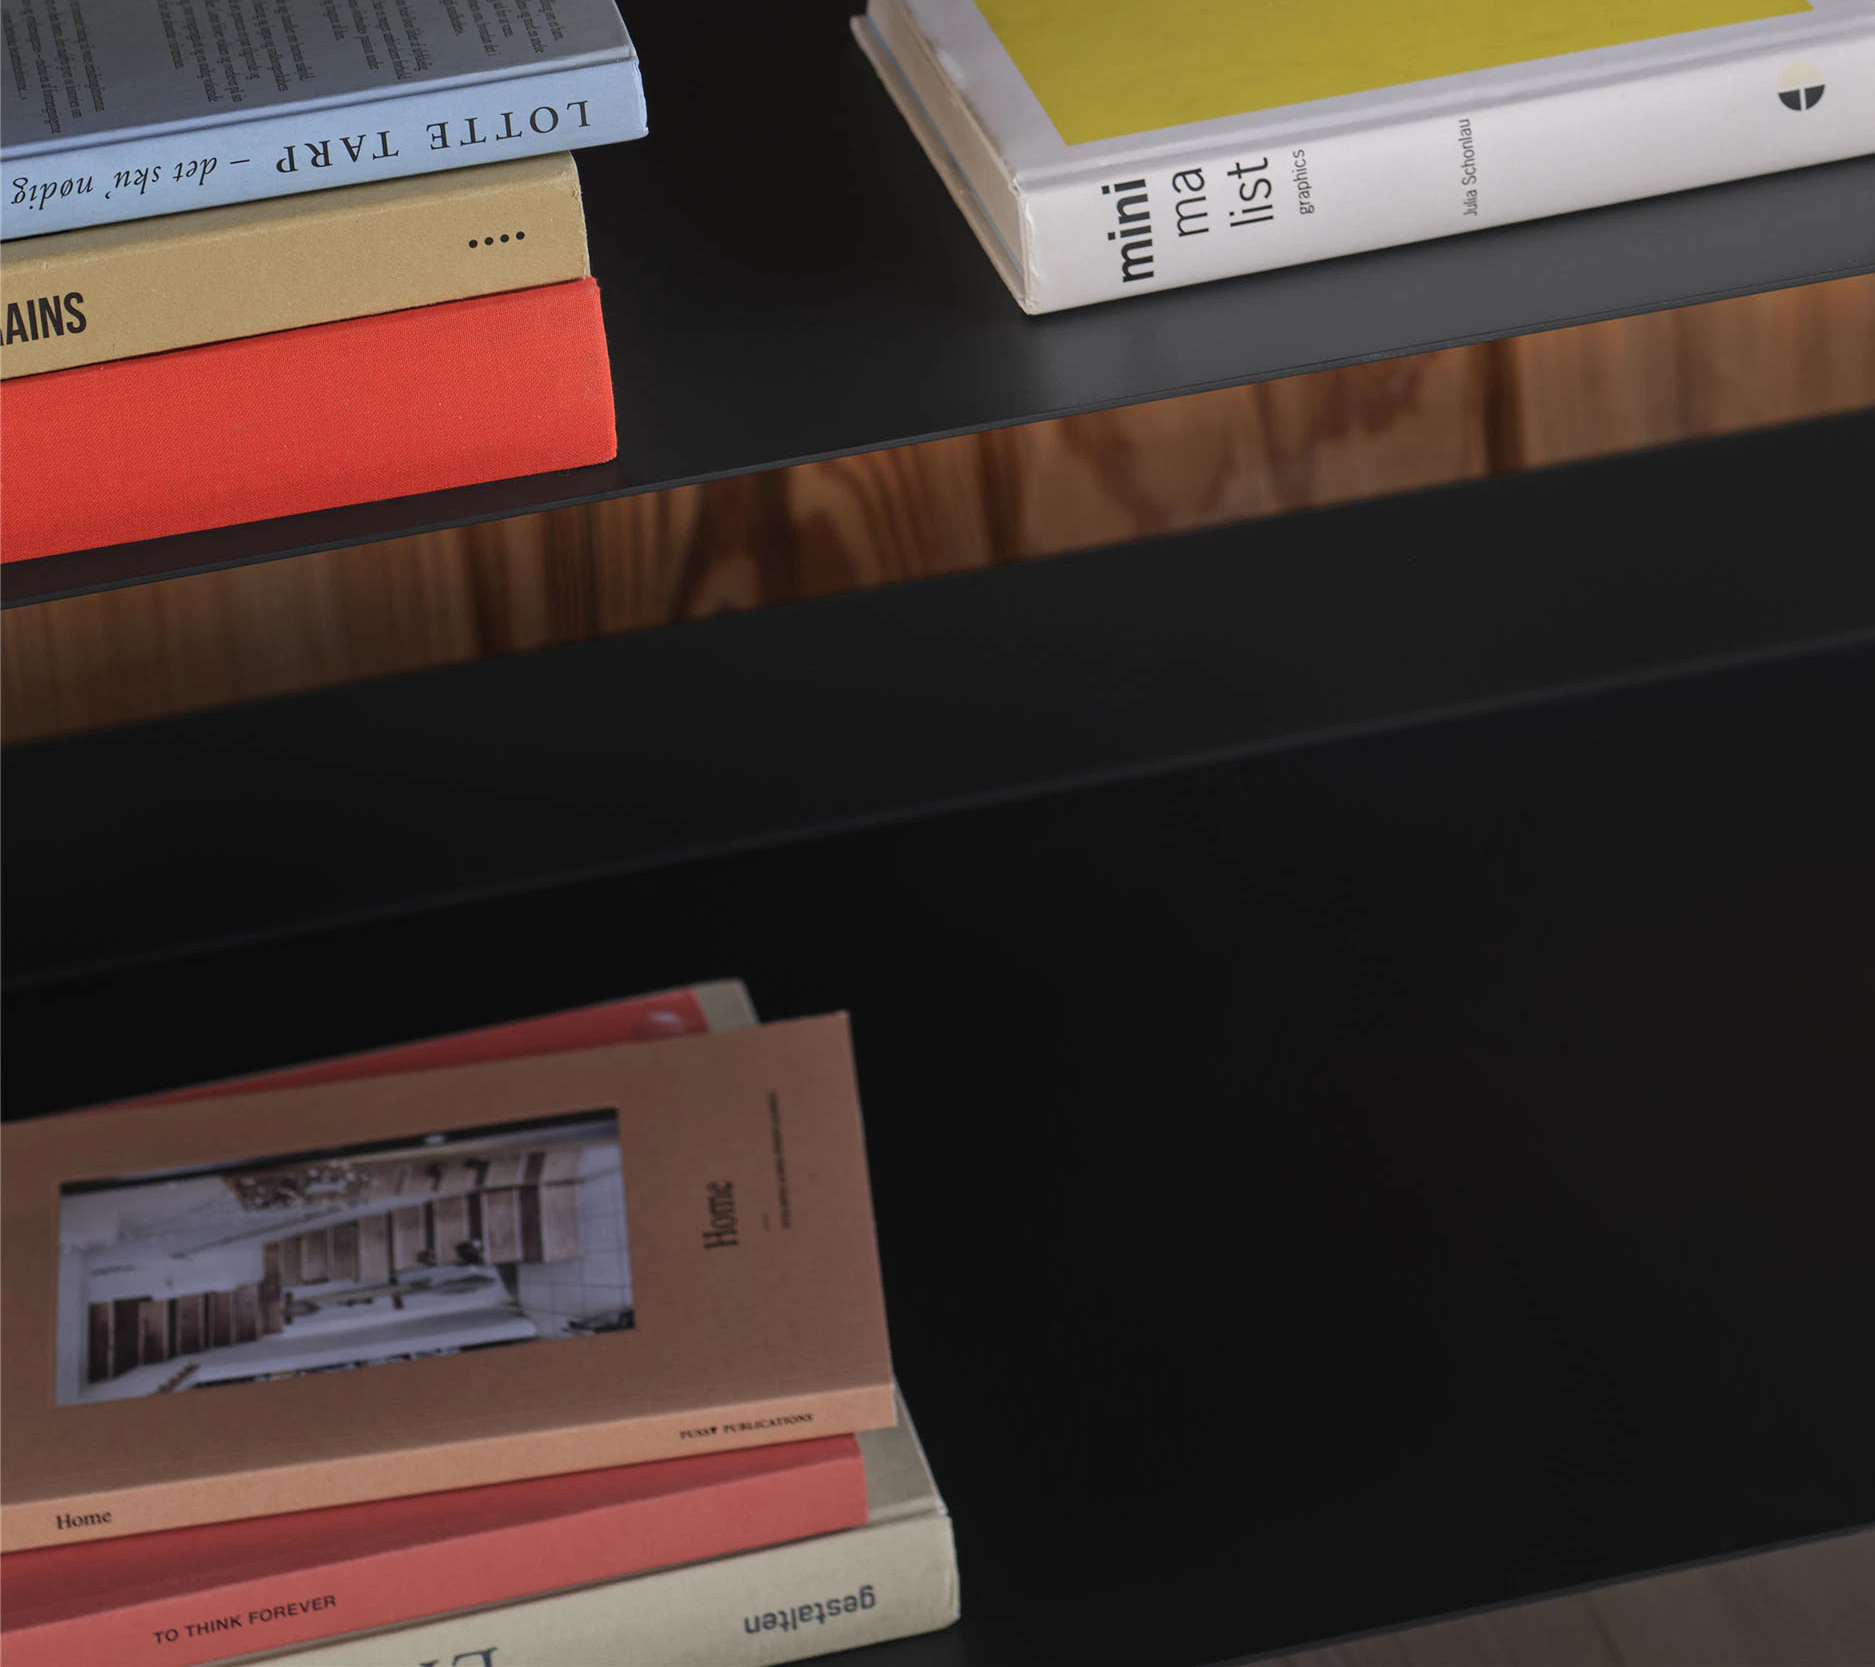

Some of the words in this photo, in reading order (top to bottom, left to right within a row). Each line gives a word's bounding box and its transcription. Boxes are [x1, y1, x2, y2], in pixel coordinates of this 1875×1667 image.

[426, 99, 591, 151] LOTTE
[172, 156, 218, 186] det
[275, 130, 400, 174] TARP
[10, 175, 94, 211] nødig
[1171, 167, 1210, 238] ma
[1226, 156, 1275, 228] list
[1290, 148, 1315, 216] graphics
[1463, 187, 1479, 217] Julia
[1101, 178, 1155, 283] mini
[0, 291, 88, 347] AINS
[701, 1180, 740, 1250] Home
[722, 1412, 815, 1435] PUBLICATIONS
[55, 1508, 113, 1532] Home
[152, 1627, 181, 1646] TO
[184, 1613, 243, 1640] THINK
[247, 1594, 338, 1626] FOREVER
[743, 1584, 877, 1635] gestalten
